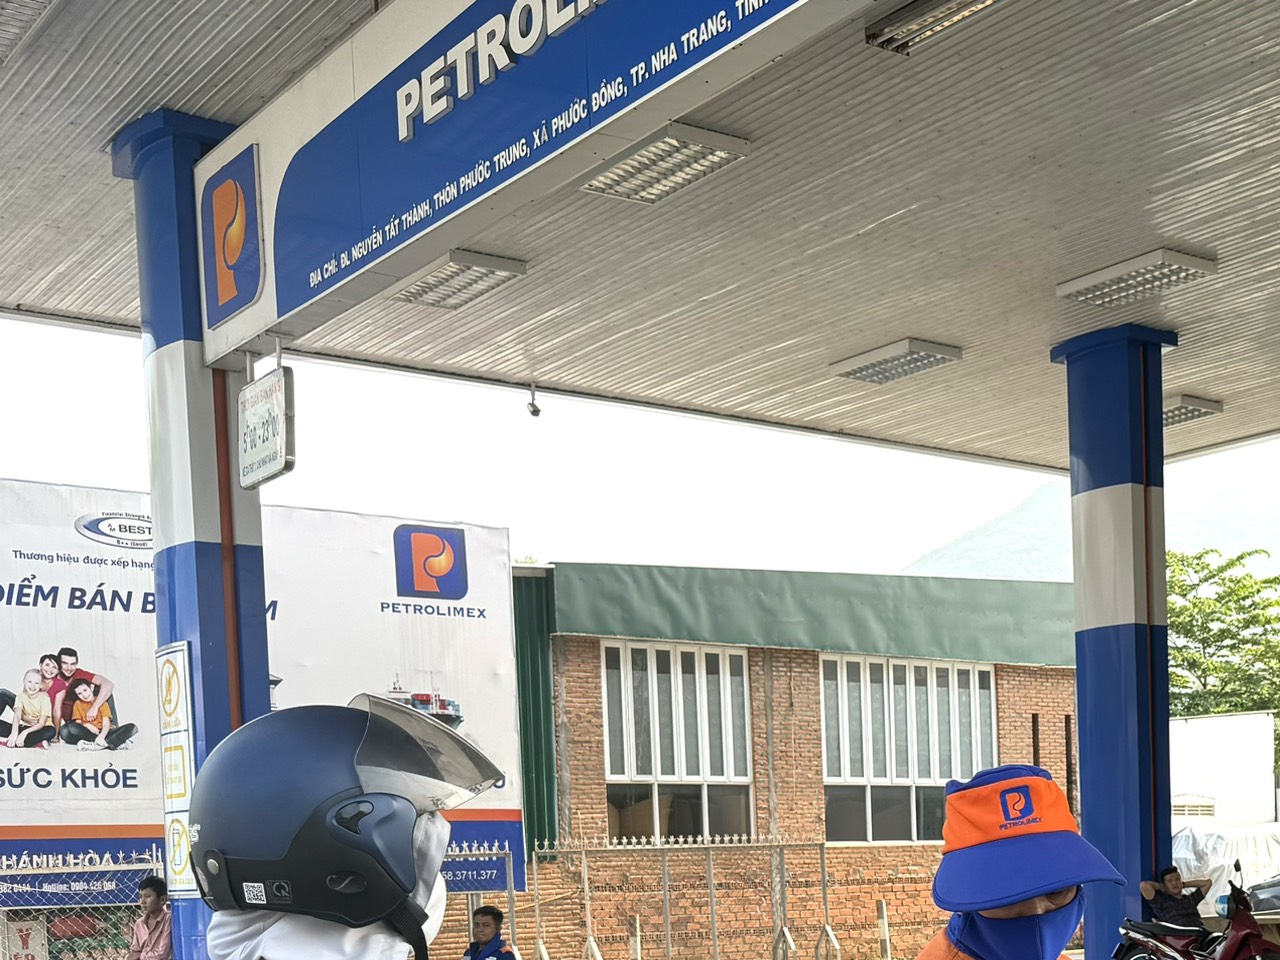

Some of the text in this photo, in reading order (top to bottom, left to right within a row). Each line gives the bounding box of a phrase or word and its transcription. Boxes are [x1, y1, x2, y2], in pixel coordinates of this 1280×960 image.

[396, 0, 606, 142] PETROL
[309, 268, 322, 288] ĐỊA
[351, 225, 383, 262] NGUYỄN
[384, 215, 400, 241] TẤT
[401, 199, 433, 231] THÀNH,
[433, 181, 458, 210] THÔN
[459, 160, 491, 194] PHƯỚC
[493, 138, 530, 173] TRUNG,
[532, 120, 549, 149] XÃ
[551, 97, 588, 137] PHƯỚC
[592, 76, 628, 112] ĐỒNG,
[630, 61, 650, 87] TP.
[651, 42, 679, 75] NHA
[680, 10, 732, 54] TRANG,
[12, 550, 54, 564] Thương
[56, 553, 79, 565] hiệu
[82, 555, 108, 568] được
[111, 557, 129, 569] xếp
[0, 574, 59, 608] IỂM
[67, 583, 133, 613] BÁN
[380, 602, 487, 619] PETROLIMEX
[61, 762, 138, 789] KHỎE
